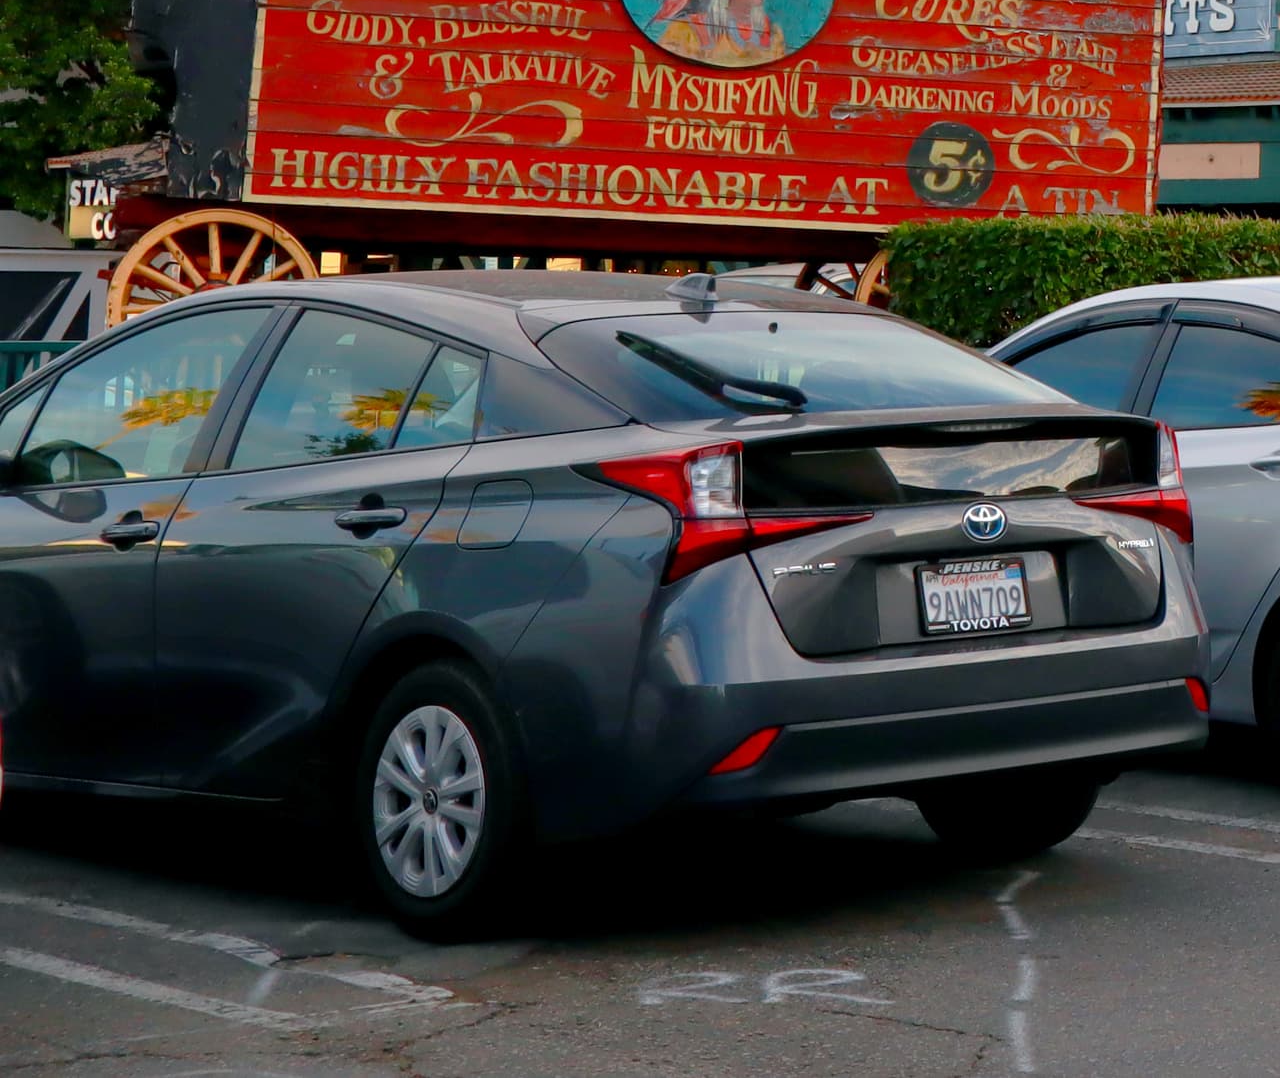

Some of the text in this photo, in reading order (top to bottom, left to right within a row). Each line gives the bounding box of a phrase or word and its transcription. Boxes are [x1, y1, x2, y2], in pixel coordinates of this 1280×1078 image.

[428, 0, 593, 44] BLISSFUL
[368, 49, 617, 100] & TALKATIVE
[850, 32, 1044, 75] GREASELESS
[626, 44, 819, 119] MYSTIFYING
[849, 75, 1113, 120] DARKENING MOODS
[1045, 63, 1073, 90] &
[645, 115, 795, 156] FORMULA
[269, 139, 1126, 218] HIGHLY FASHIONABLE AT 5¢ A TIN
[941, 572, 1000, 588] California
[943, 561, 1000, 574] PENSKE
[929, 585, 1021, 622] 9AWN709
[950, 616, 1010, 632] TOYOTA
